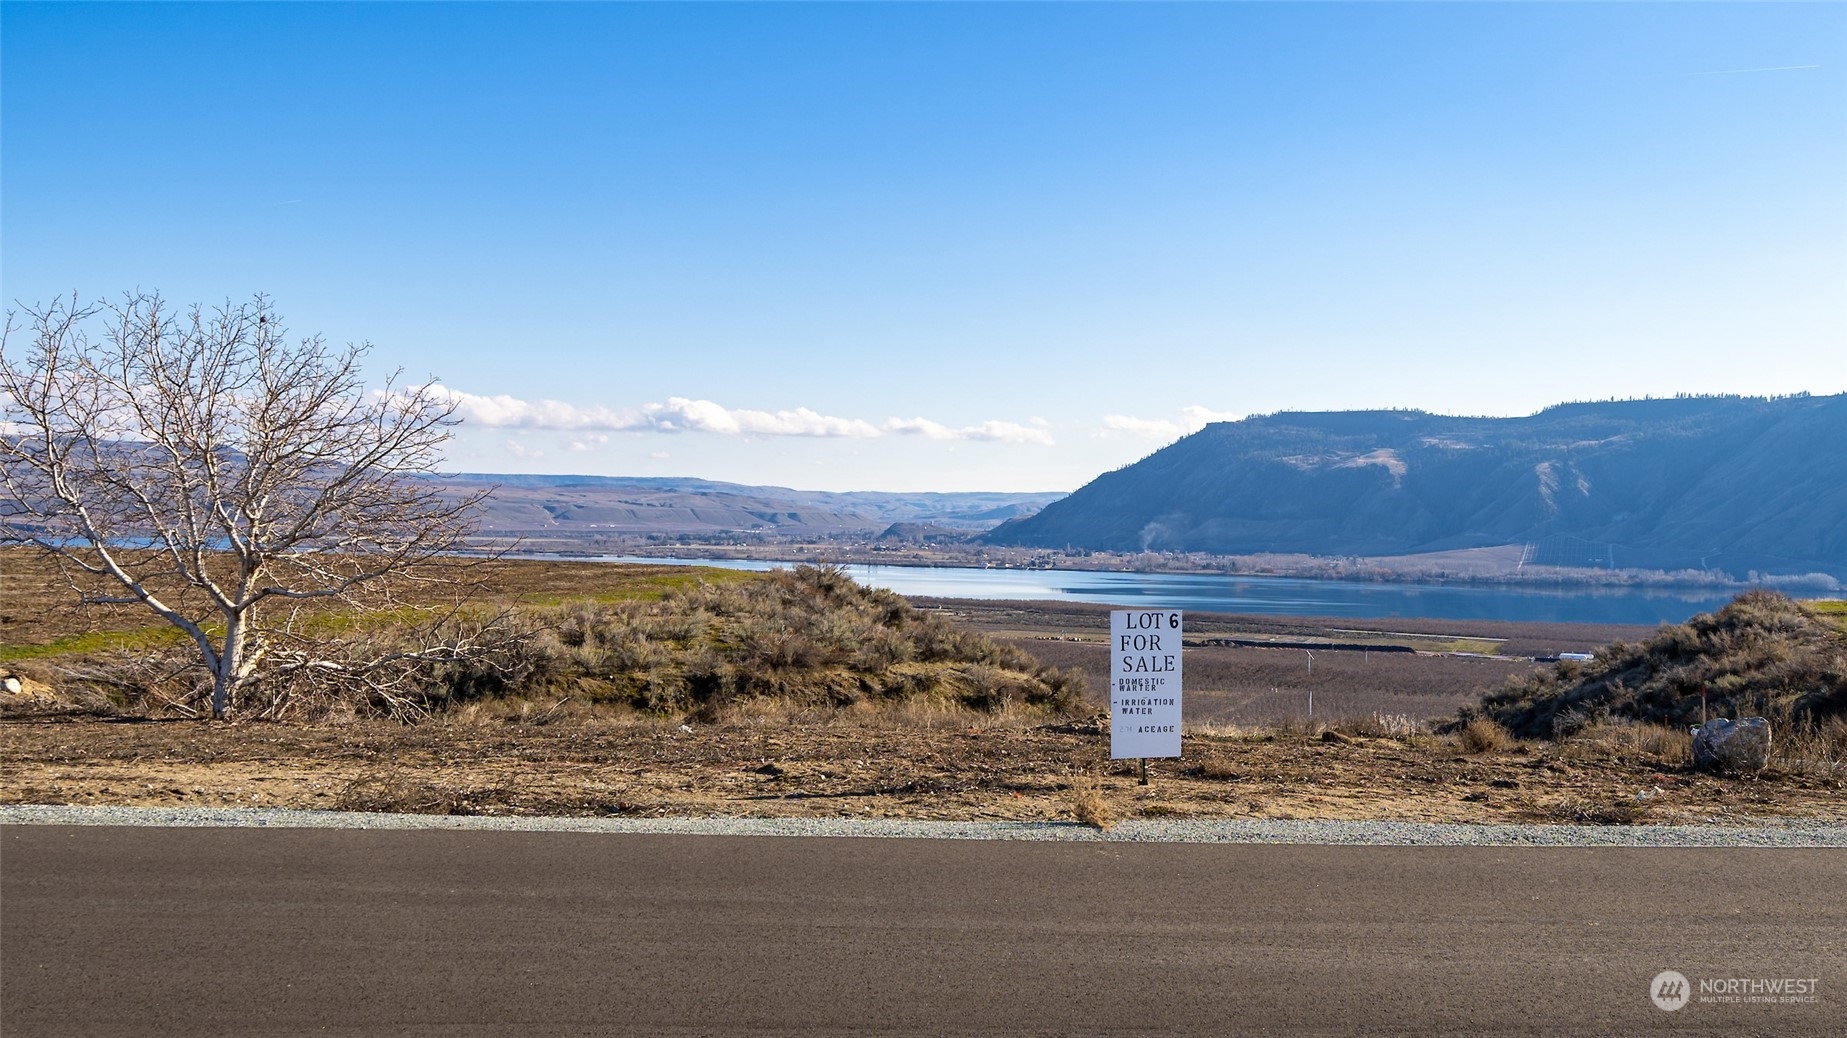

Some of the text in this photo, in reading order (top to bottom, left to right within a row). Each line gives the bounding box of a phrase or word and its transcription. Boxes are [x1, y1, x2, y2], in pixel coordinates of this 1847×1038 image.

[1127, 613, 1179, 629] LOT 6
[1120, 634, 1162, 652] FOR
[1122, 655, 1175, 673] SALE
[1121, 698, 1175, 706] IRRIGATION
[1121, 707, 1153, 715] WATER
[1138, 725, 1175, 733] ACEAGE
